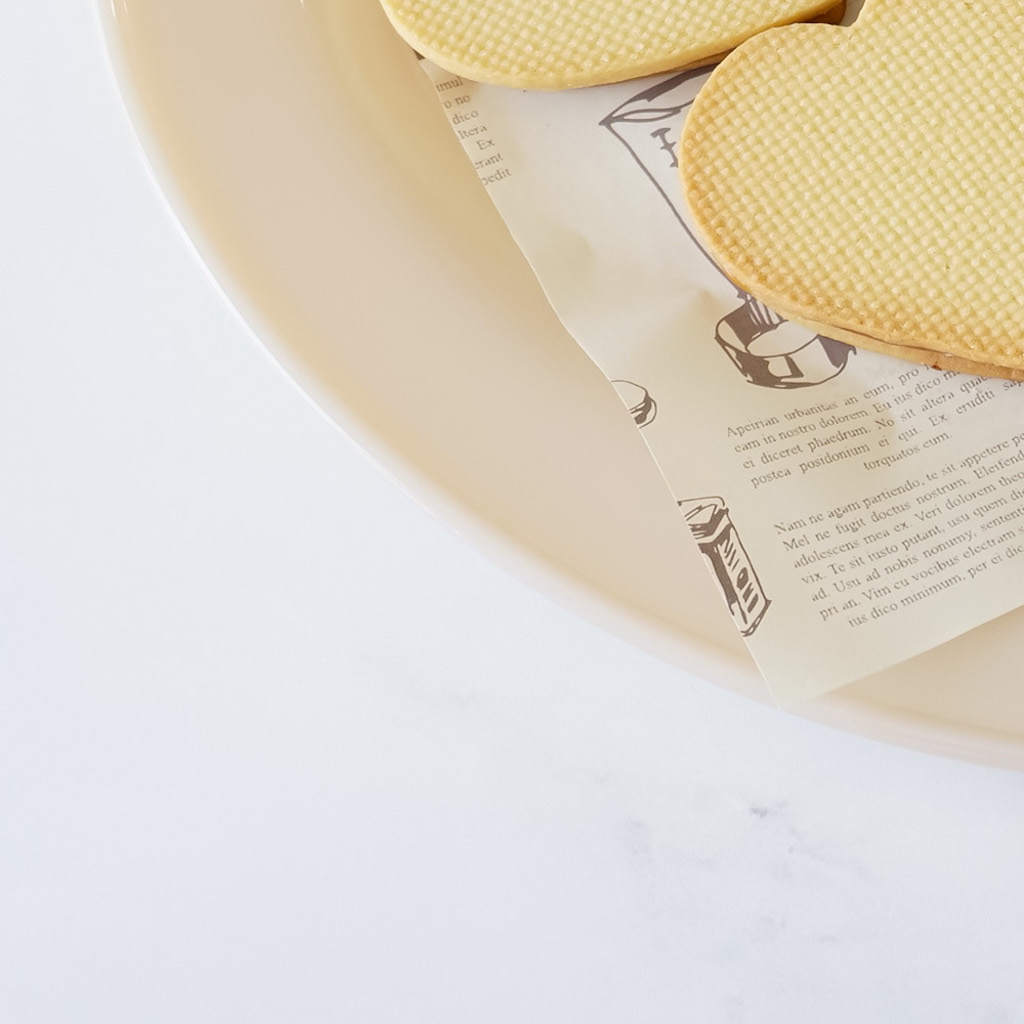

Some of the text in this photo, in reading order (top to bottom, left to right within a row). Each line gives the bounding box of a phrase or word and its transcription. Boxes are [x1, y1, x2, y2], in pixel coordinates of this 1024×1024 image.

[452, 110, 480, 125] dico
[457, 125, 489, 140] ltera
[475, 138, 496, 151] Ex
[727, 416, 780, 438] Apeirian
[783, 403, 839, 422] urbanitas
[843, 395, 859, 407] an
[897, 368, 920, 387] pro
[733, 439, 761, 453] eam
[761, 433, 777, 445] in
[777, 423, 817, 440] nostro
[914, 377, 941, 396] dico
[750, 468, 792, 490] postea
[798, 443, 871, 475] posidonium
[928, 413, 949, 427] Ex
[955, 390, 996, 415] eruditi
[760, 444, 804, 465] diceret
[807, 426, 872, 453] phaedrum.
[875, 417, 896, 431] No
[900, 408, 917, 423] sit
[921, 391, 955, 413] altera
[773, 518, 808, 535] Nam
[808, 513, 825, 525] ne
[826, 501, 862, 519] agam
[925, 472, 939, 482] te
[941, 463, 957, 477] sit
[959, 440, 1010, 469] appetere
[863, 445, 921, 471] torquatos
[781, 534, 811, 552] Mel
[814, 530, 832, 542] ne
[835, 517, 867, 535] fugit
[870, 501, 912, 524] doctus
[793, 539, 860, 569] adolescens
[862, 529, 891, 545] mea
[913, 503, 943, 522] Veri
[944, 483, 997, 511] dolorem
[826, 562, 846, 576] Te
[848, 555, 866, 569] sit
[867, 544, 899, 562] iusto
[946, 512, 971, 529] usu
[972, 497, 1009, 518] quem
[818, 605, 839, 622] pri
[861, 585, 892, 601] Vim
[893, 577, 910, 591] cu
[910, 555, 961, 581] vocibus
[962, 530, 1017, 559] electram
[832, 577, 862, 593] Usu
[865, 567, 881, 583] ad
[883, 554, 920, 575] nobis
[847, 613, 869, 628] ius
[870, 602, 899, 620] dico
[967, 560, 988, 579] per
[990, 552, 1004, 567] ei
